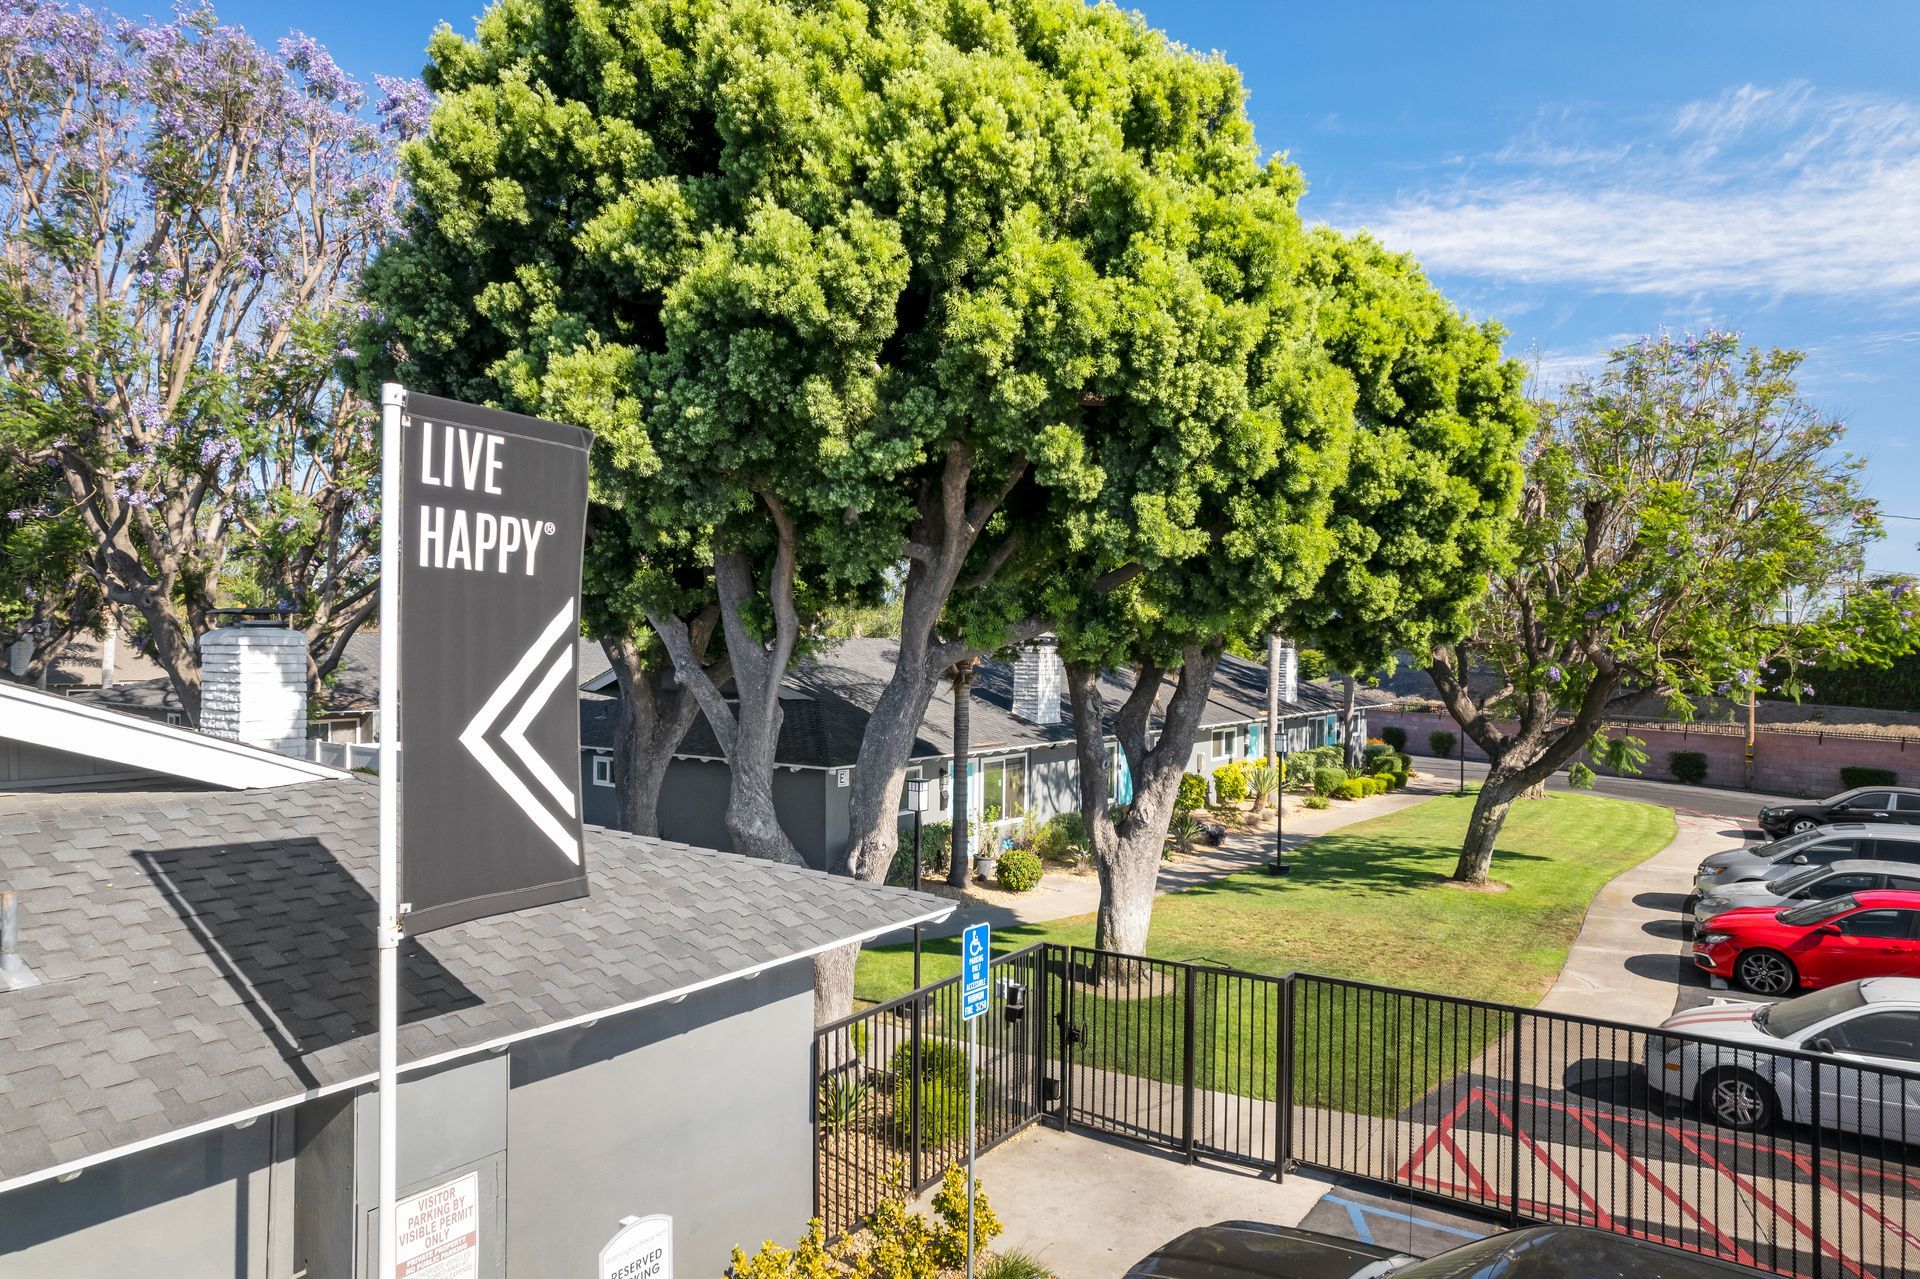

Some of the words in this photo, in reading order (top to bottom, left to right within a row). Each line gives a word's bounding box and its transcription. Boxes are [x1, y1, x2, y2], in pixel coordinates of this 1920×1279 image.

[421, 422, 505, 495] LIVE
[969, 954, 984, 965] PARKING
[972, 964, 981, 973] ONLY
[966, 978, 986, 990] ACCESSIBLE
[964, 1005, 973, 1016] FINE
[975, 1000, 987, 1012] $250
[968, 991, 984, 1004] MINIMUM
[418, 1187, 456, 1211] VISITOR
[408, 1202, 450, 1230] PARKING
[453, 1195, 465, 1210] BY
[399, 1221, 437, 1246] VISIBLE
[440, 1205, 474, 1229] PERMIT
[425, 1228, 450, 1248] ONLY
[405, 1267, 415, 1276] NO
[416, 1256, 440, 1271] PUBLIC
[441, 1242, 468, 1260] PARKING
[407, 1250, 434, 1267] PRIVATE
[434, 1237, 467, 1255] PROPERTY
[611, 1248, 662, 1279] RESERVED
